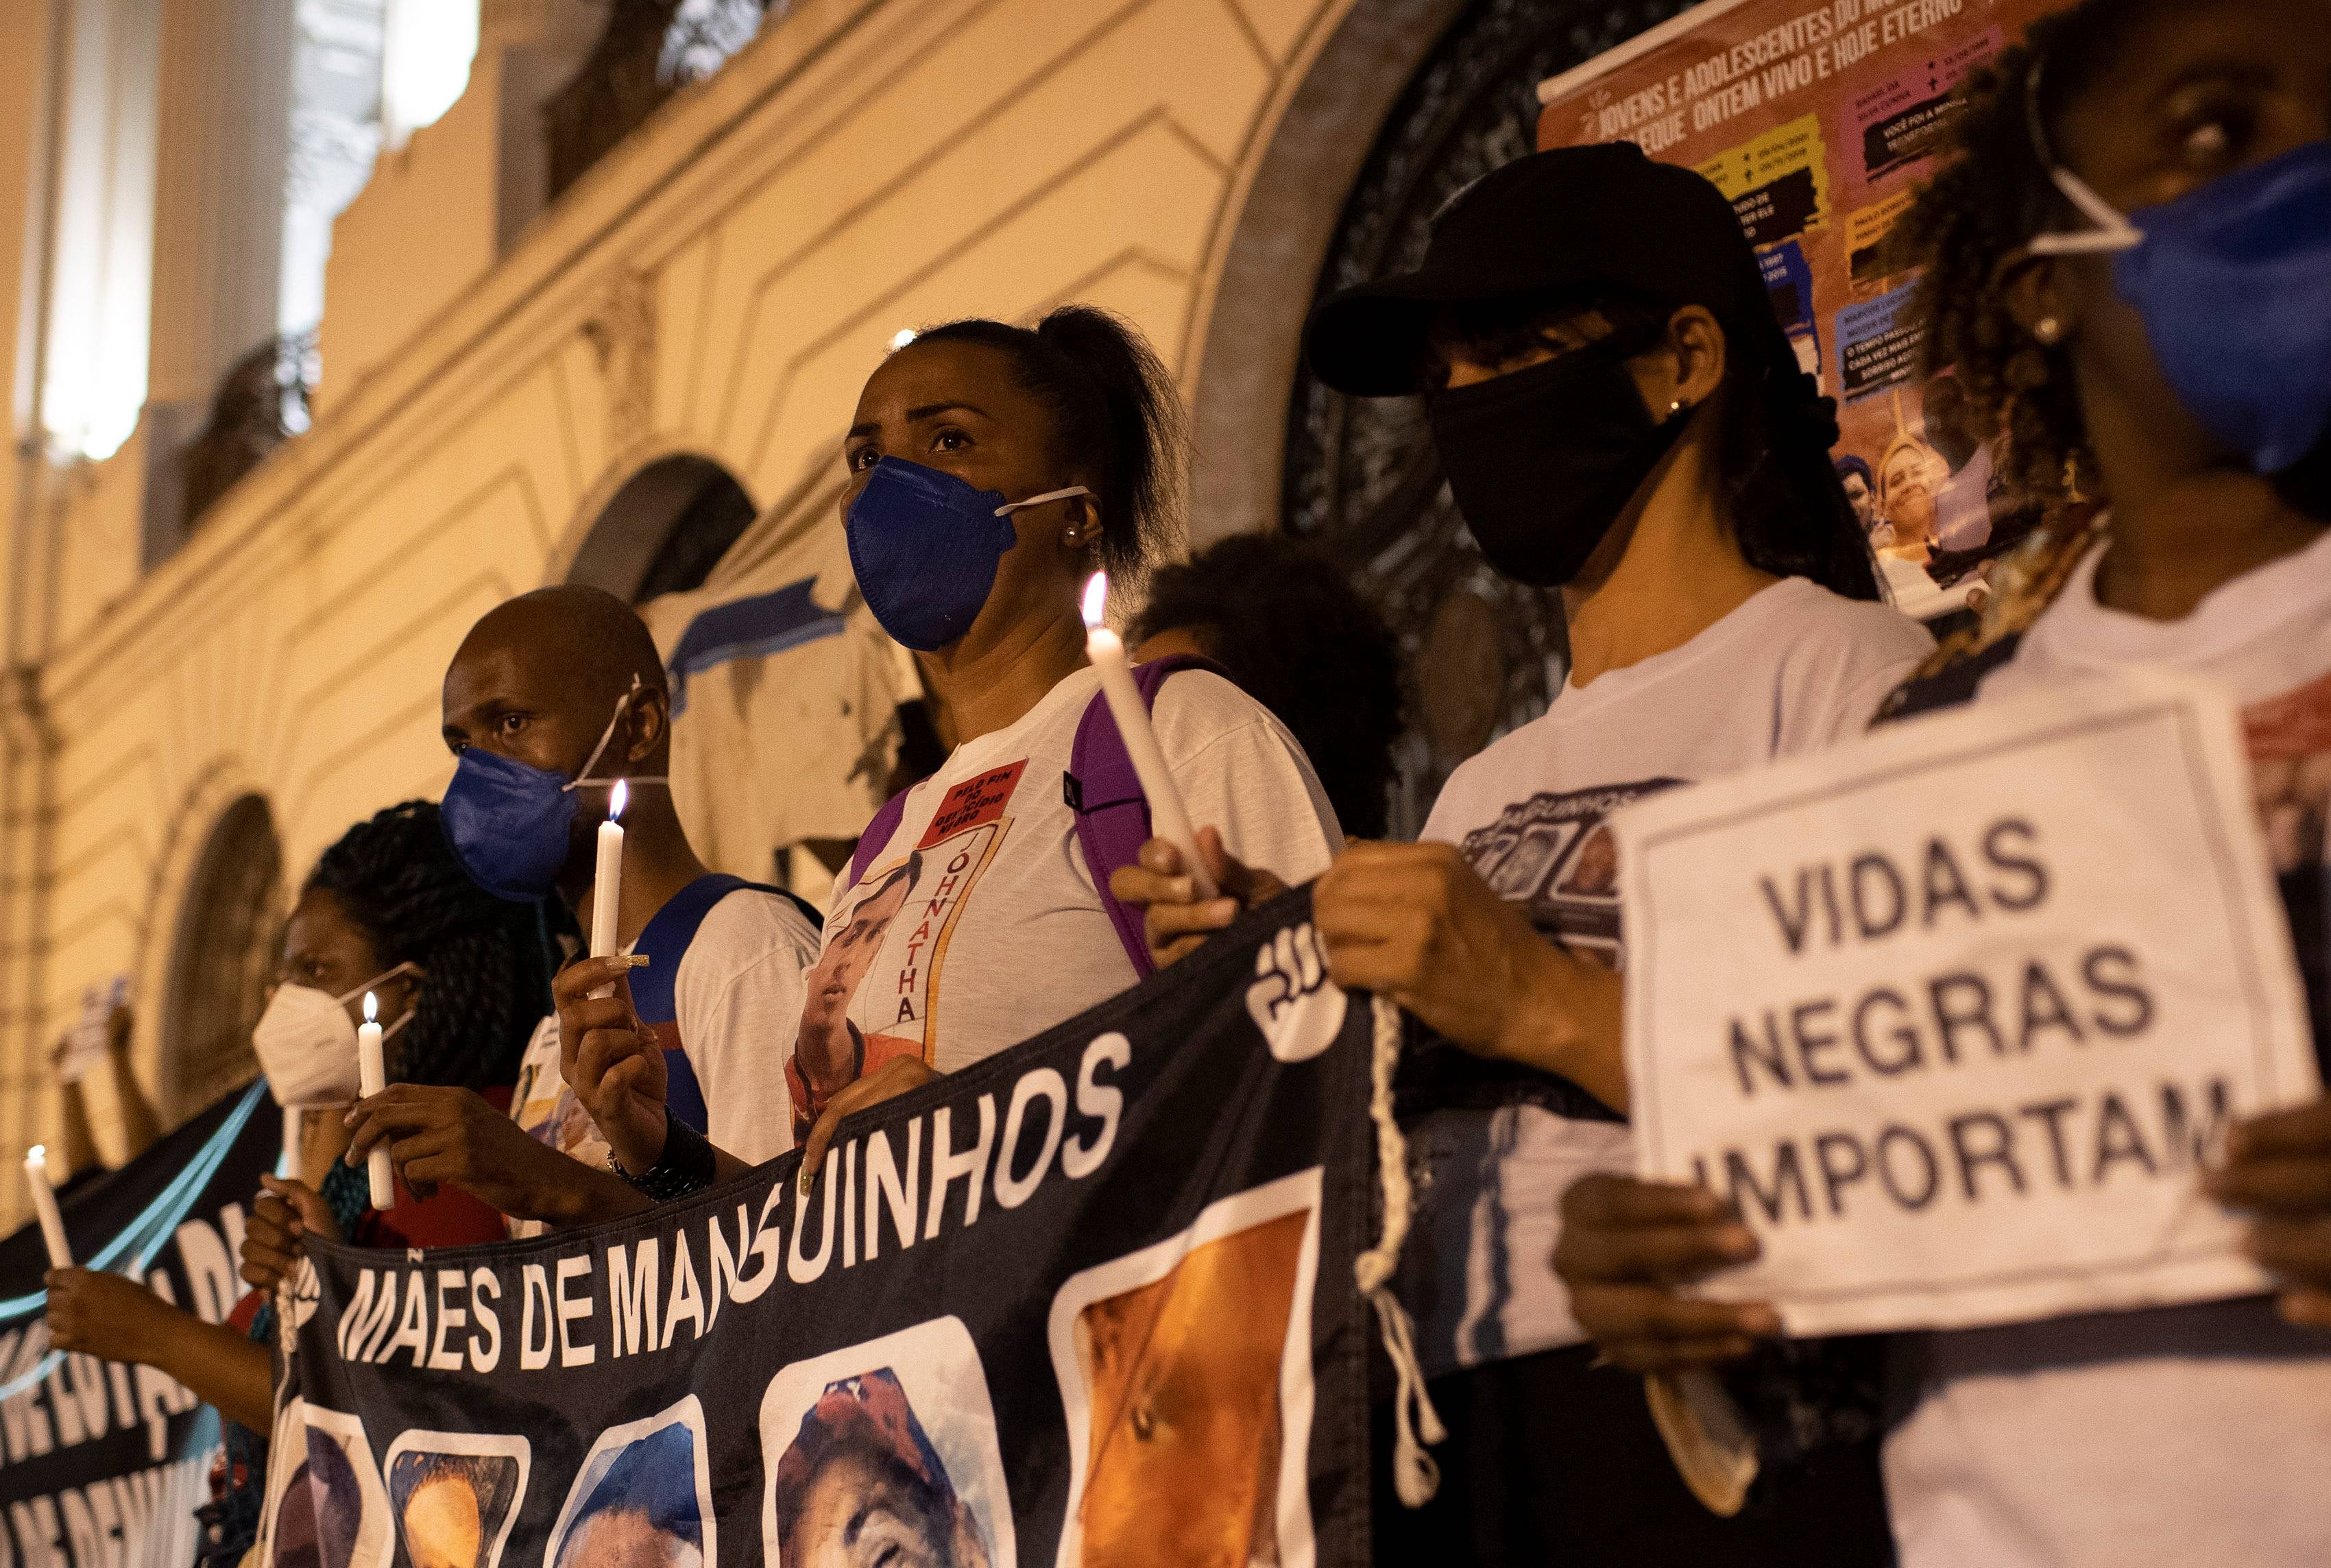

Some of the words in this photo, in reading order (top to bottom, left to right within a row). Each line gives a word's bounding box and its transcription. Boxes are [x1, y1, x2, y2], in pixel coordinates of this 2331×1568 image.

[1598, 82, 1666, 141] JOVENS
[1667, 74, 1682, 107] E
[1684, 5, 1833, 100] ADOLESCENTES
[1693, 75, 1761, 132] ONTEM
[1761, 54, 1814, 100] VIVO
[1816, 45, 1832, 81] E
[1833, 19, 1880, 72] HOJE
[1883, 116, 1909, 138] VOCÊ
[1907, 112, 1925, 127] FOI
[1847, 353, 1872, 372] CADA
[964, 788, 982, 805] DO
[897, 832, 980, 1023] JOHNATHA
[1757, 819, 2052, 957] VIDAS
[1722, 943, 2158, 1098] NEGRAS
[337, 1248, 502, 1373] MÃES
[520, 1254, 596, 1371] DE
[607, 1031, 1133, 1359] MANGUINHOS
[1689, 1073, 2232, 1229] IMPORTAM
